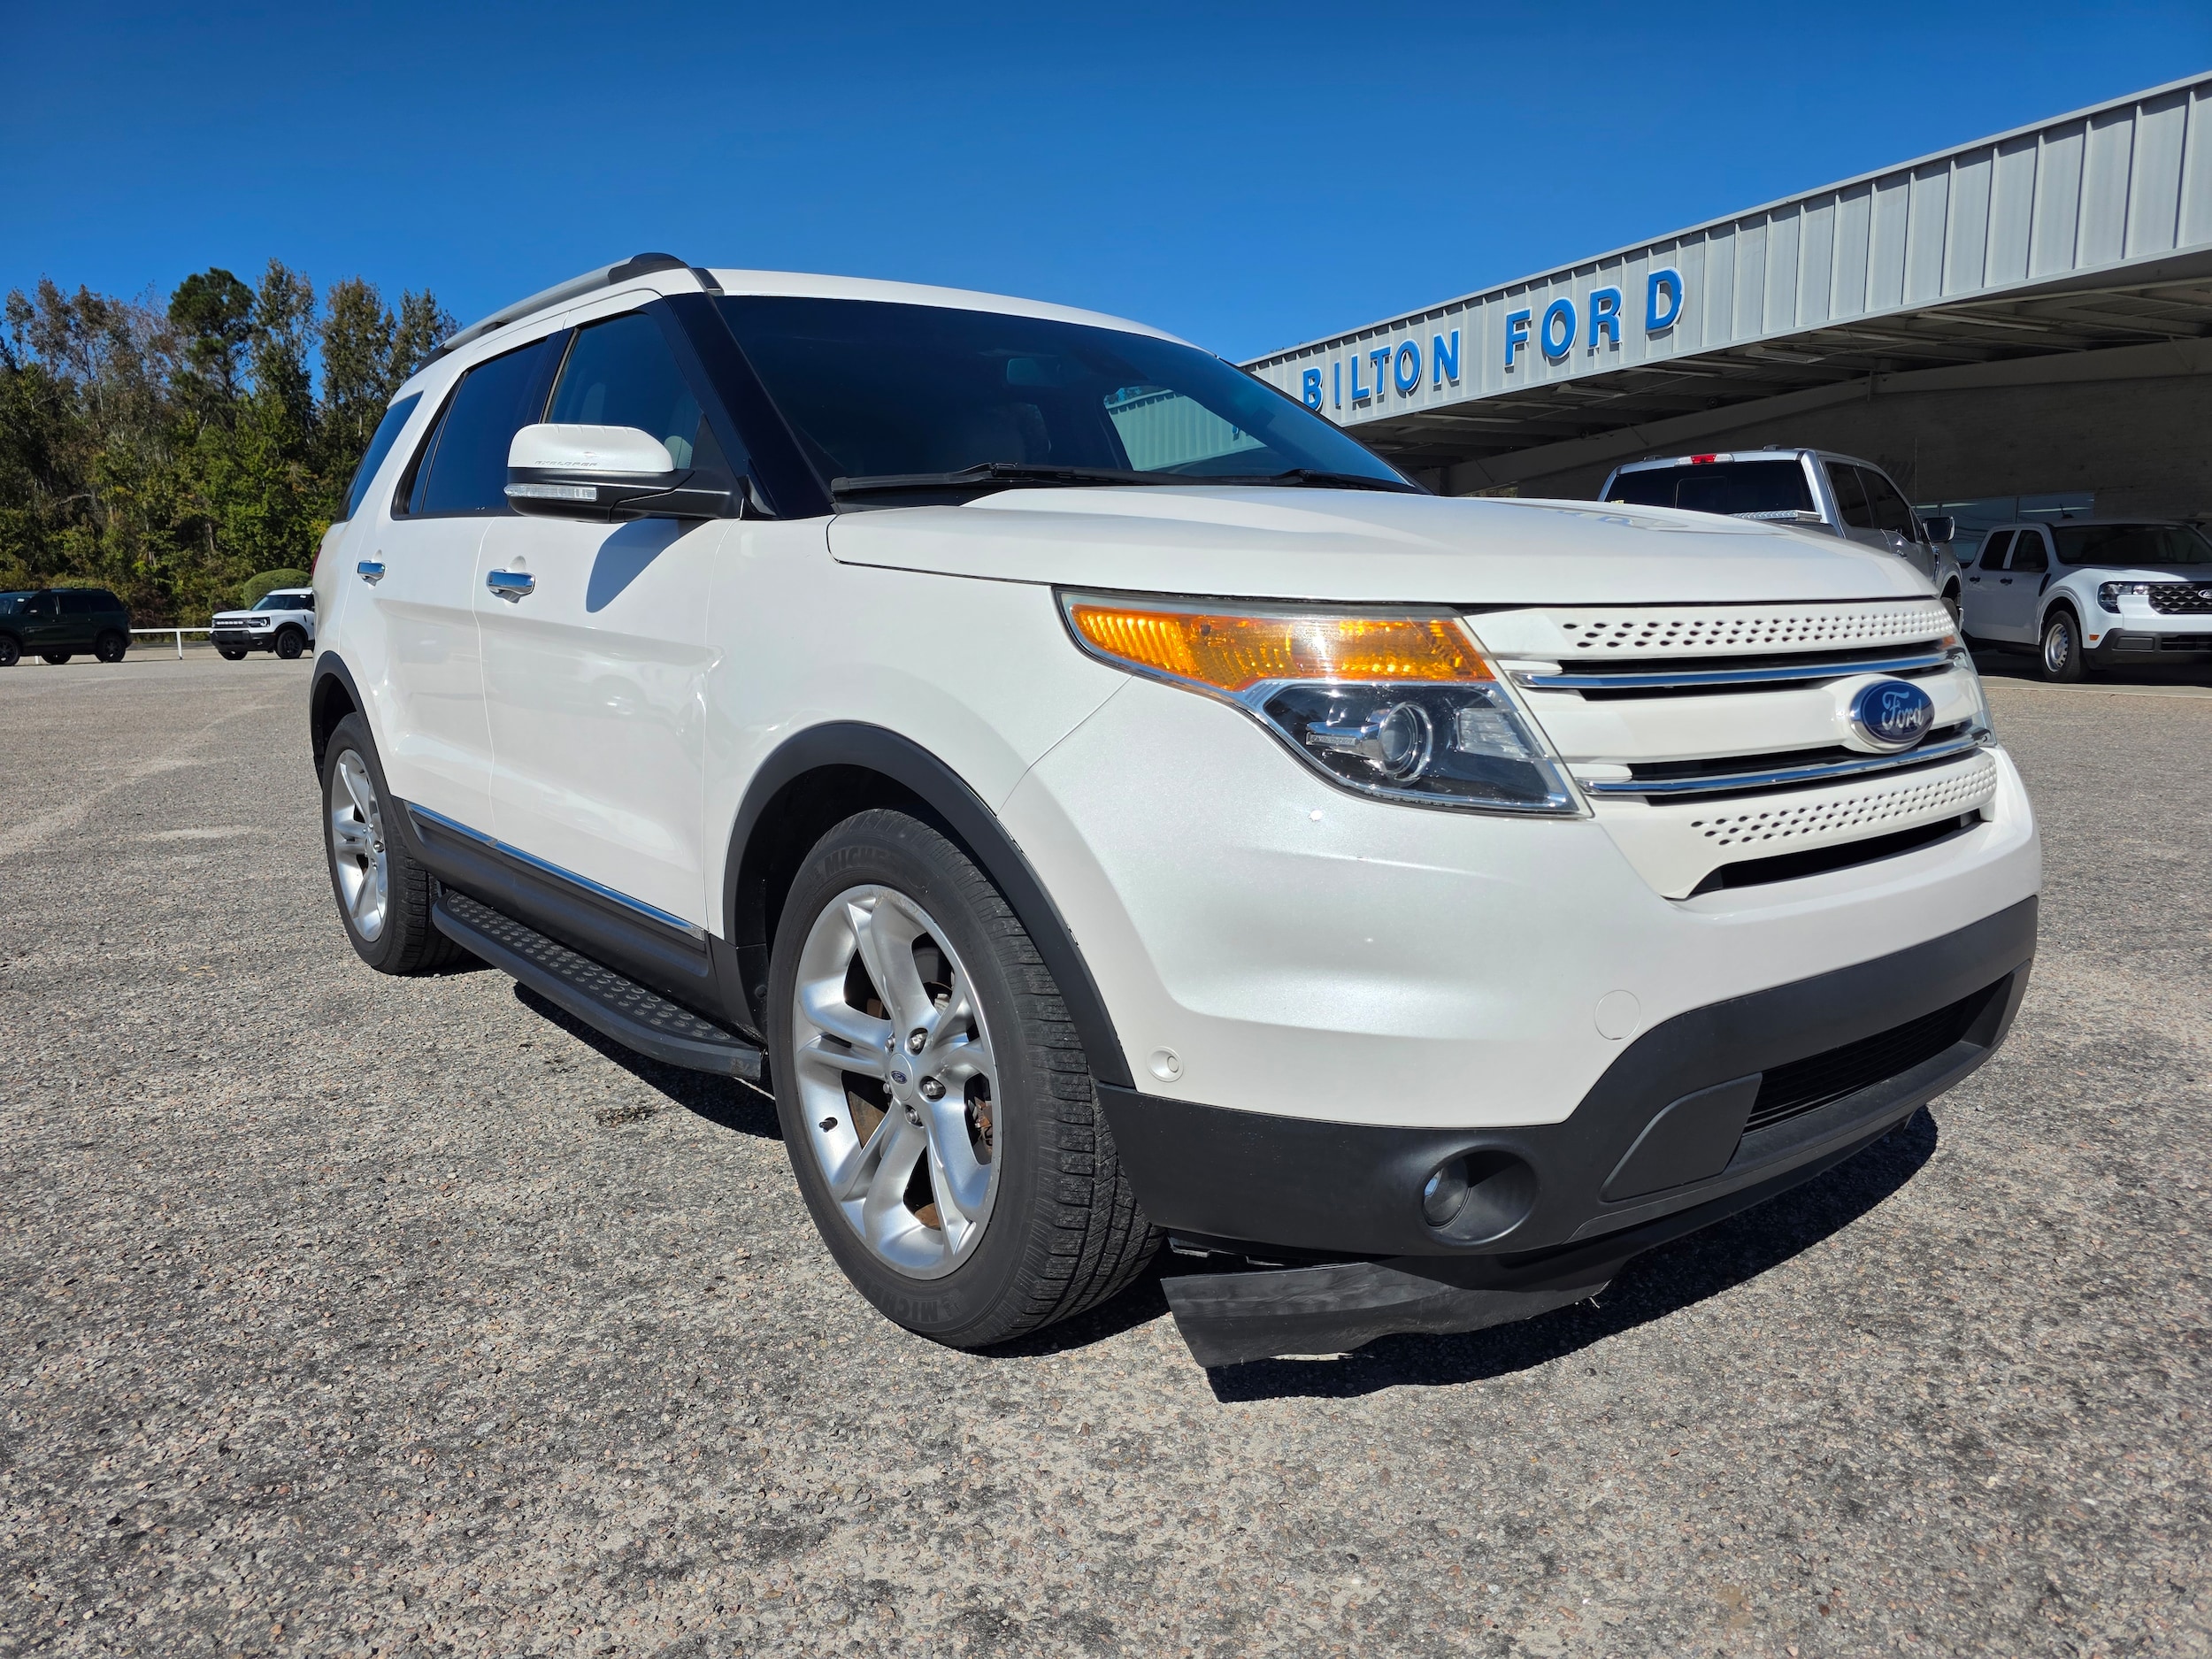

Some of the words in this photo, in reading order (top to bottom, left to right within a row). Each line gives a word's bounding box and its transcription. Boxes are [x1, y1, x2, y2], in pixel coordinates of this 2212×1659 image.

[1302, 327, 1461, 412] BILTON
[1505, 267, 1685, 366] FORD
[1882, 691, 1924, 730] Ford
